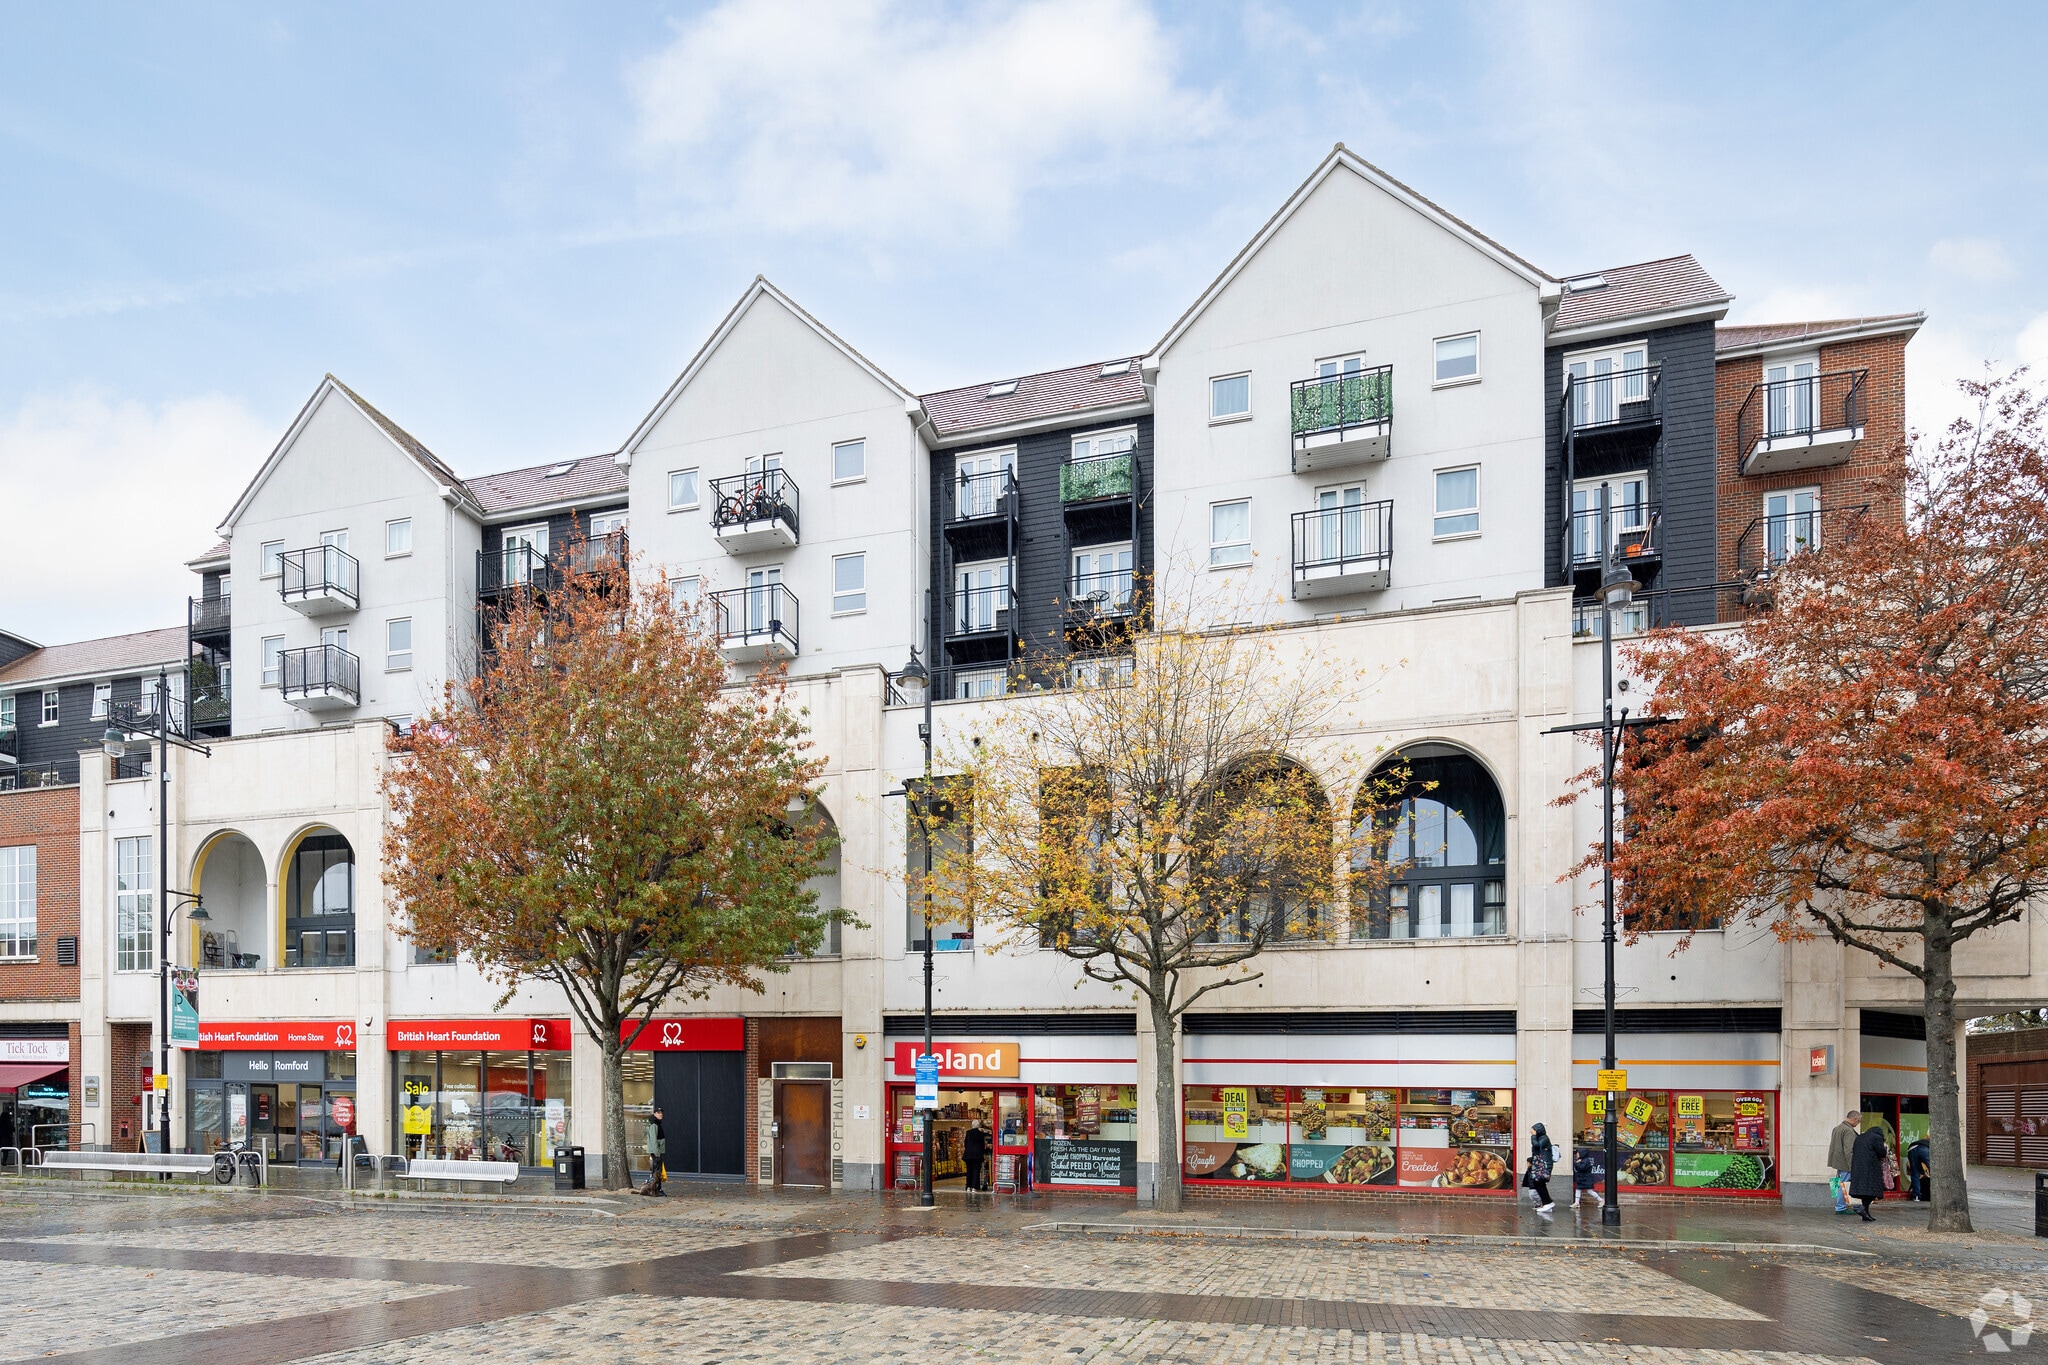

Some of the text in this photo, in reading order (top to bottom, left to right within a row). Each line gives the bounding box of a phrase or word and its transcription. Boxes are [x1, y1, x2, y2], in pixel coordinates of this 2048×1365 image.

[199, 1032, 213, 1041] tish
[214, 1032, 235, 1041] Heart
[236, 1032, 278, 1041] Foundation
[398, 1031, 500, 1041] British Heart Foundation
[6, 1042, 48, 1054] Tick Tock
[910, 1048, 1000, 1070] Ieland
[1812, 1055, 1826, 1067] Iceland
[249, 1060, 308, 1070] Hello Romford
[405, 1081, 429, 1095] Sale
[1225, 1092, 1245, 1102] DEAL
[1633, 1106, 1644, 1116] £5
[1681, 1102, 1700, 1110] FREE
[760, 1079, 772, 1156] LOFTHAUS
[1050, 1152, 1069, 1162] Caught
[1186, 1154, 1215, 1170] Caught
[1071, 1162, 1092, 1170] PEELED
[1093, 1161, 1120, 1172] Whisked
[1292, 1159, 1323, 1168] CHOPPED
[1402, 1161, 1438, 1171] Created
